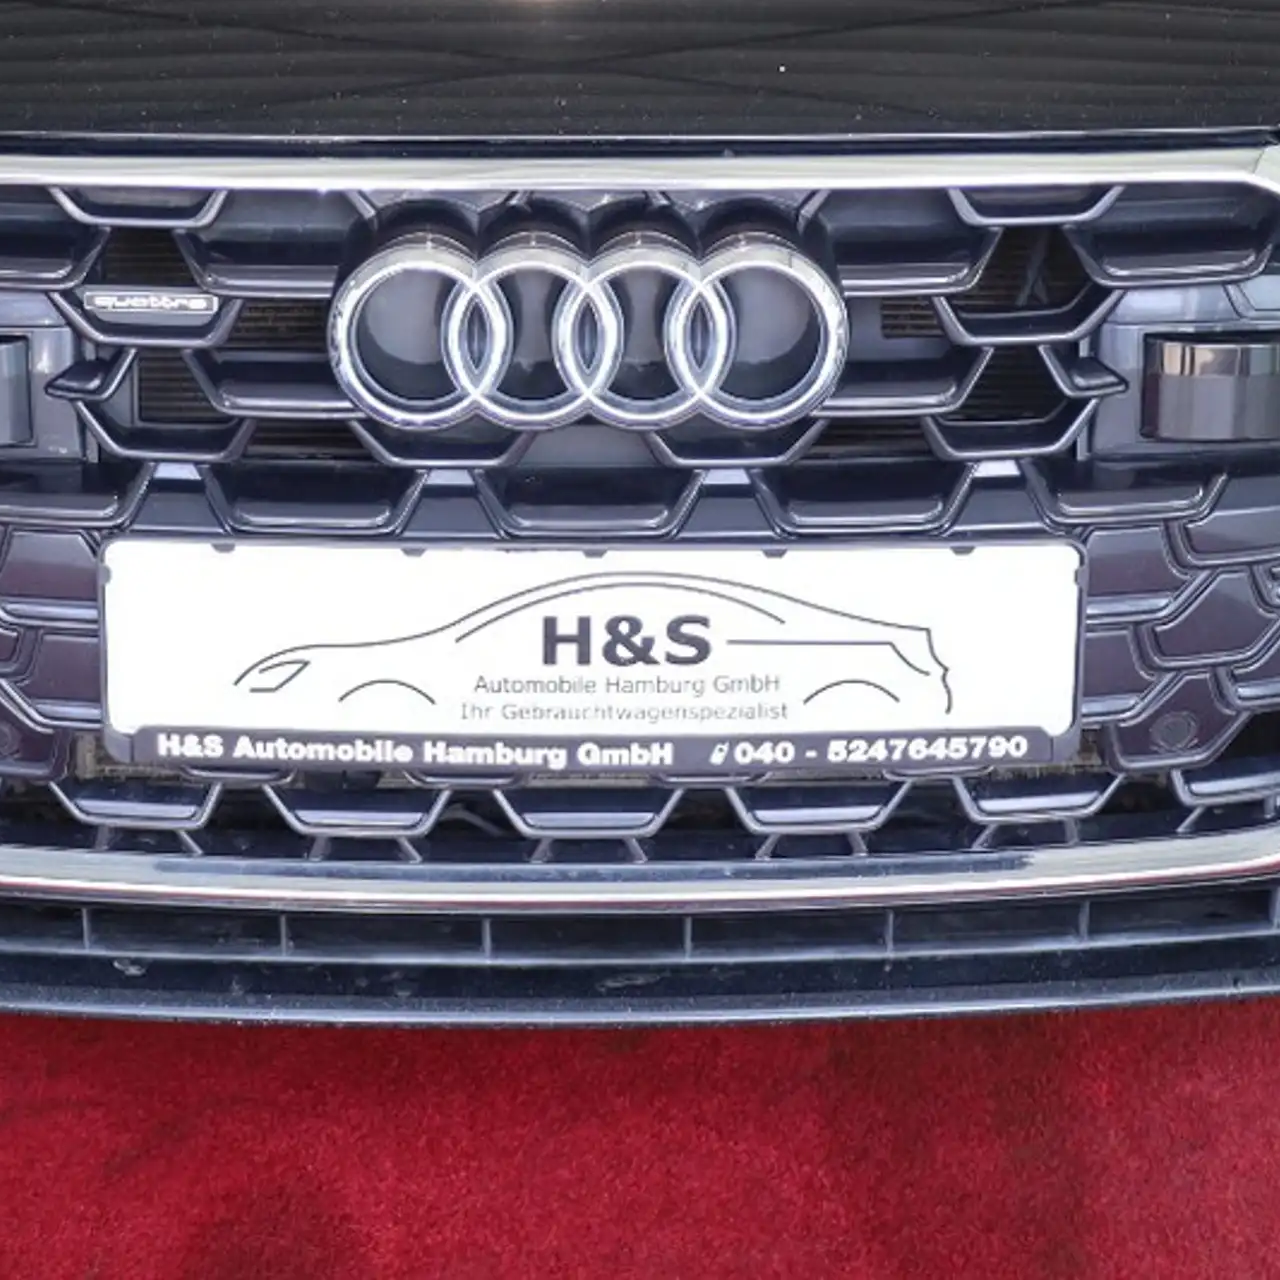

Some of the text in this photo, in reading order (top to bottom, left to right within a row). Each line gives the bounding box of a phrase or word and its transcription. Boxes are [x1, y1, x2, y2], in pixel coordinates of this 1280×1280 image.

[93, 296, 208, 310] quattro
[542, 614, 712, 666] H&S
[473, 675, 781, 698] Automobile Hamburg GmbH
[460, 702, 788, 723] Ihr Gebrauchtwagenspezialist
[157, 733, 224, 758] H&S
[232, 736, 414, 763] Automobile
[423, 741, 568, 770] Hamburg
[577, 742, 676, 765] GmbH
[734, 741, 795, 765] 040
[826, 735, 1028, 762] 5247645790
